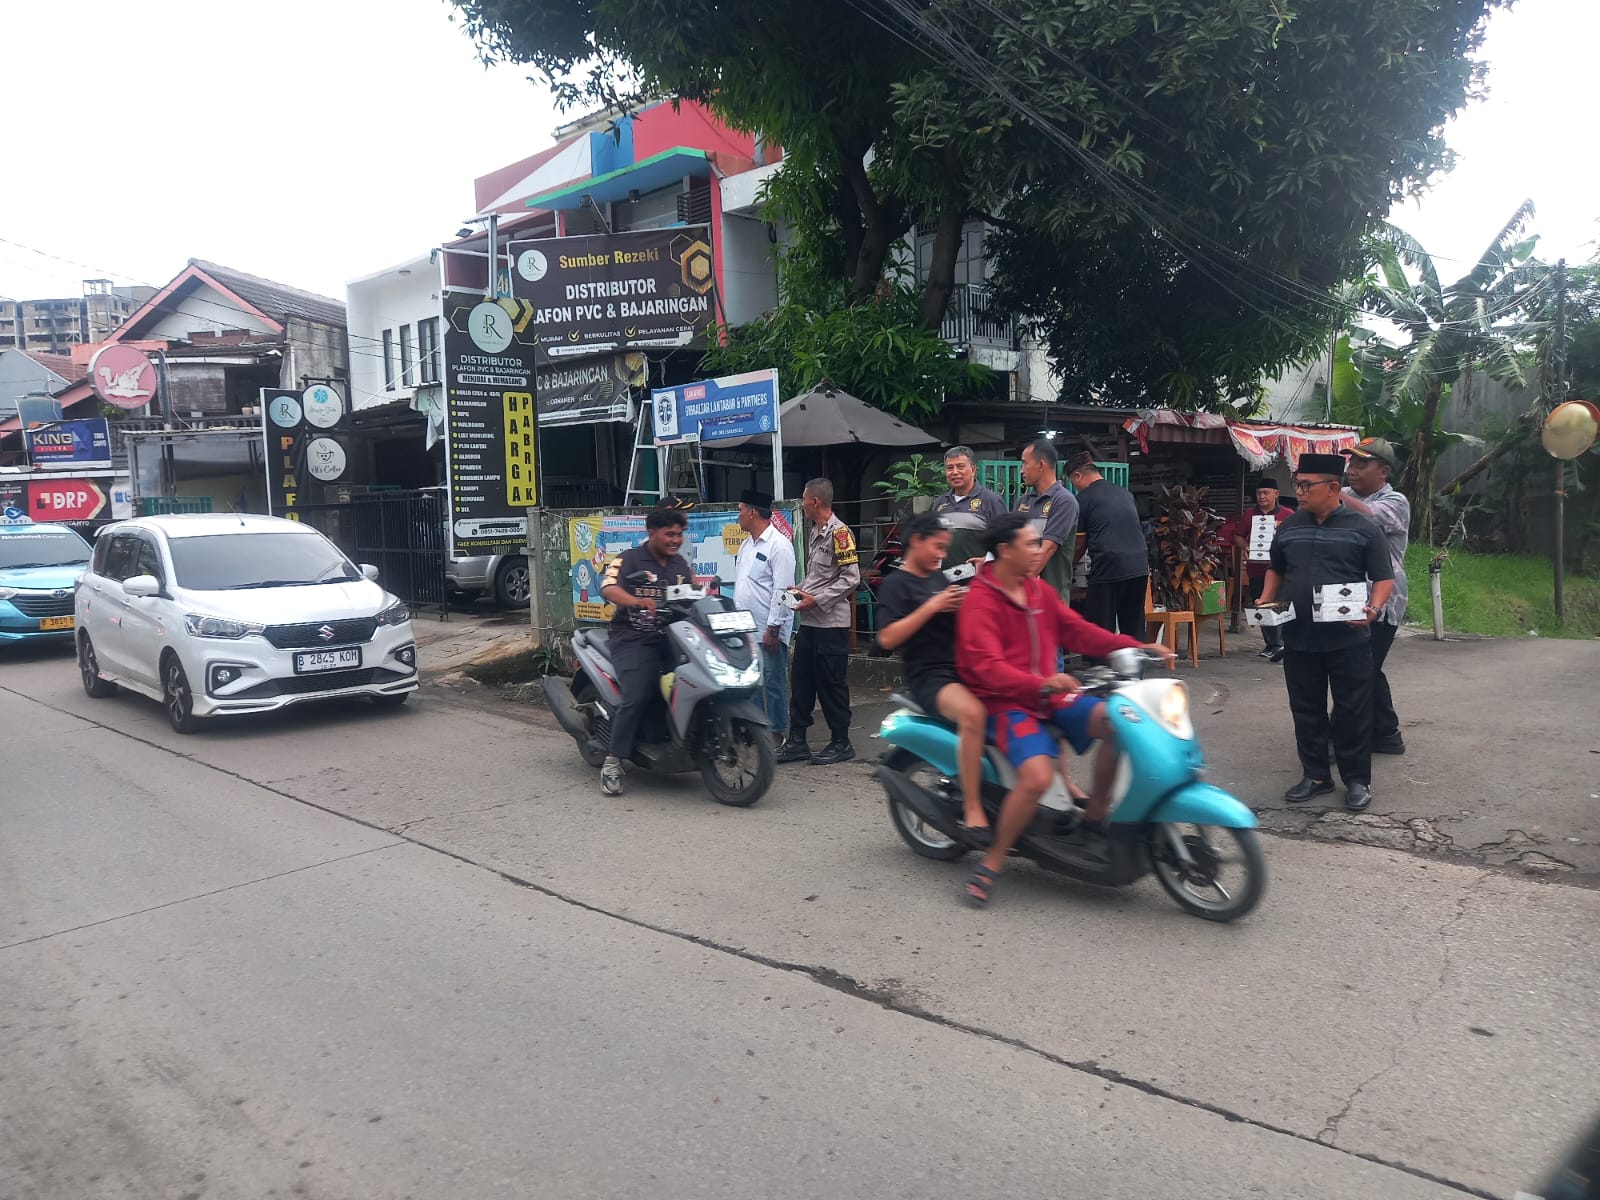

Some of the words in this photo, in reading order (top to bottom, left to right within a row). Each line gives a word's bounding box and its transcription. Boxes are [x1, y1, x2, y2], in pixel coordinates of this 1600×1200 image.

[559, 251, 610, 269] Sumber
[614, 248, 659, 265] Rezeki
[565, 278, 656, 300] DISTRIBUTOR
[534, 306, 572, 325] AFON
[575, 304, 602, 322] PVC
[606, 302, 617, 319] &
[621, 296, 708, 318] BAJARINGAN
[638, 327, 675, 335] PELAYANAN
[452, 364, 477, 372] PLAFON
[496, 367, 531, 375] BAJARINGAN
[460, 354, 522, 367] DISTRIBUTOR
[551, 366, 608, 389] BAJARINGAN
[741, 393, 768, 408] PARTNERS
[32, 433, 73, 445] KING
[508, 396, 521, 502] HARGA
[522, 397, 533, 501] PABRIK
[298, 655, 305, 666] B
[310, 653, 335, 665] 2845
